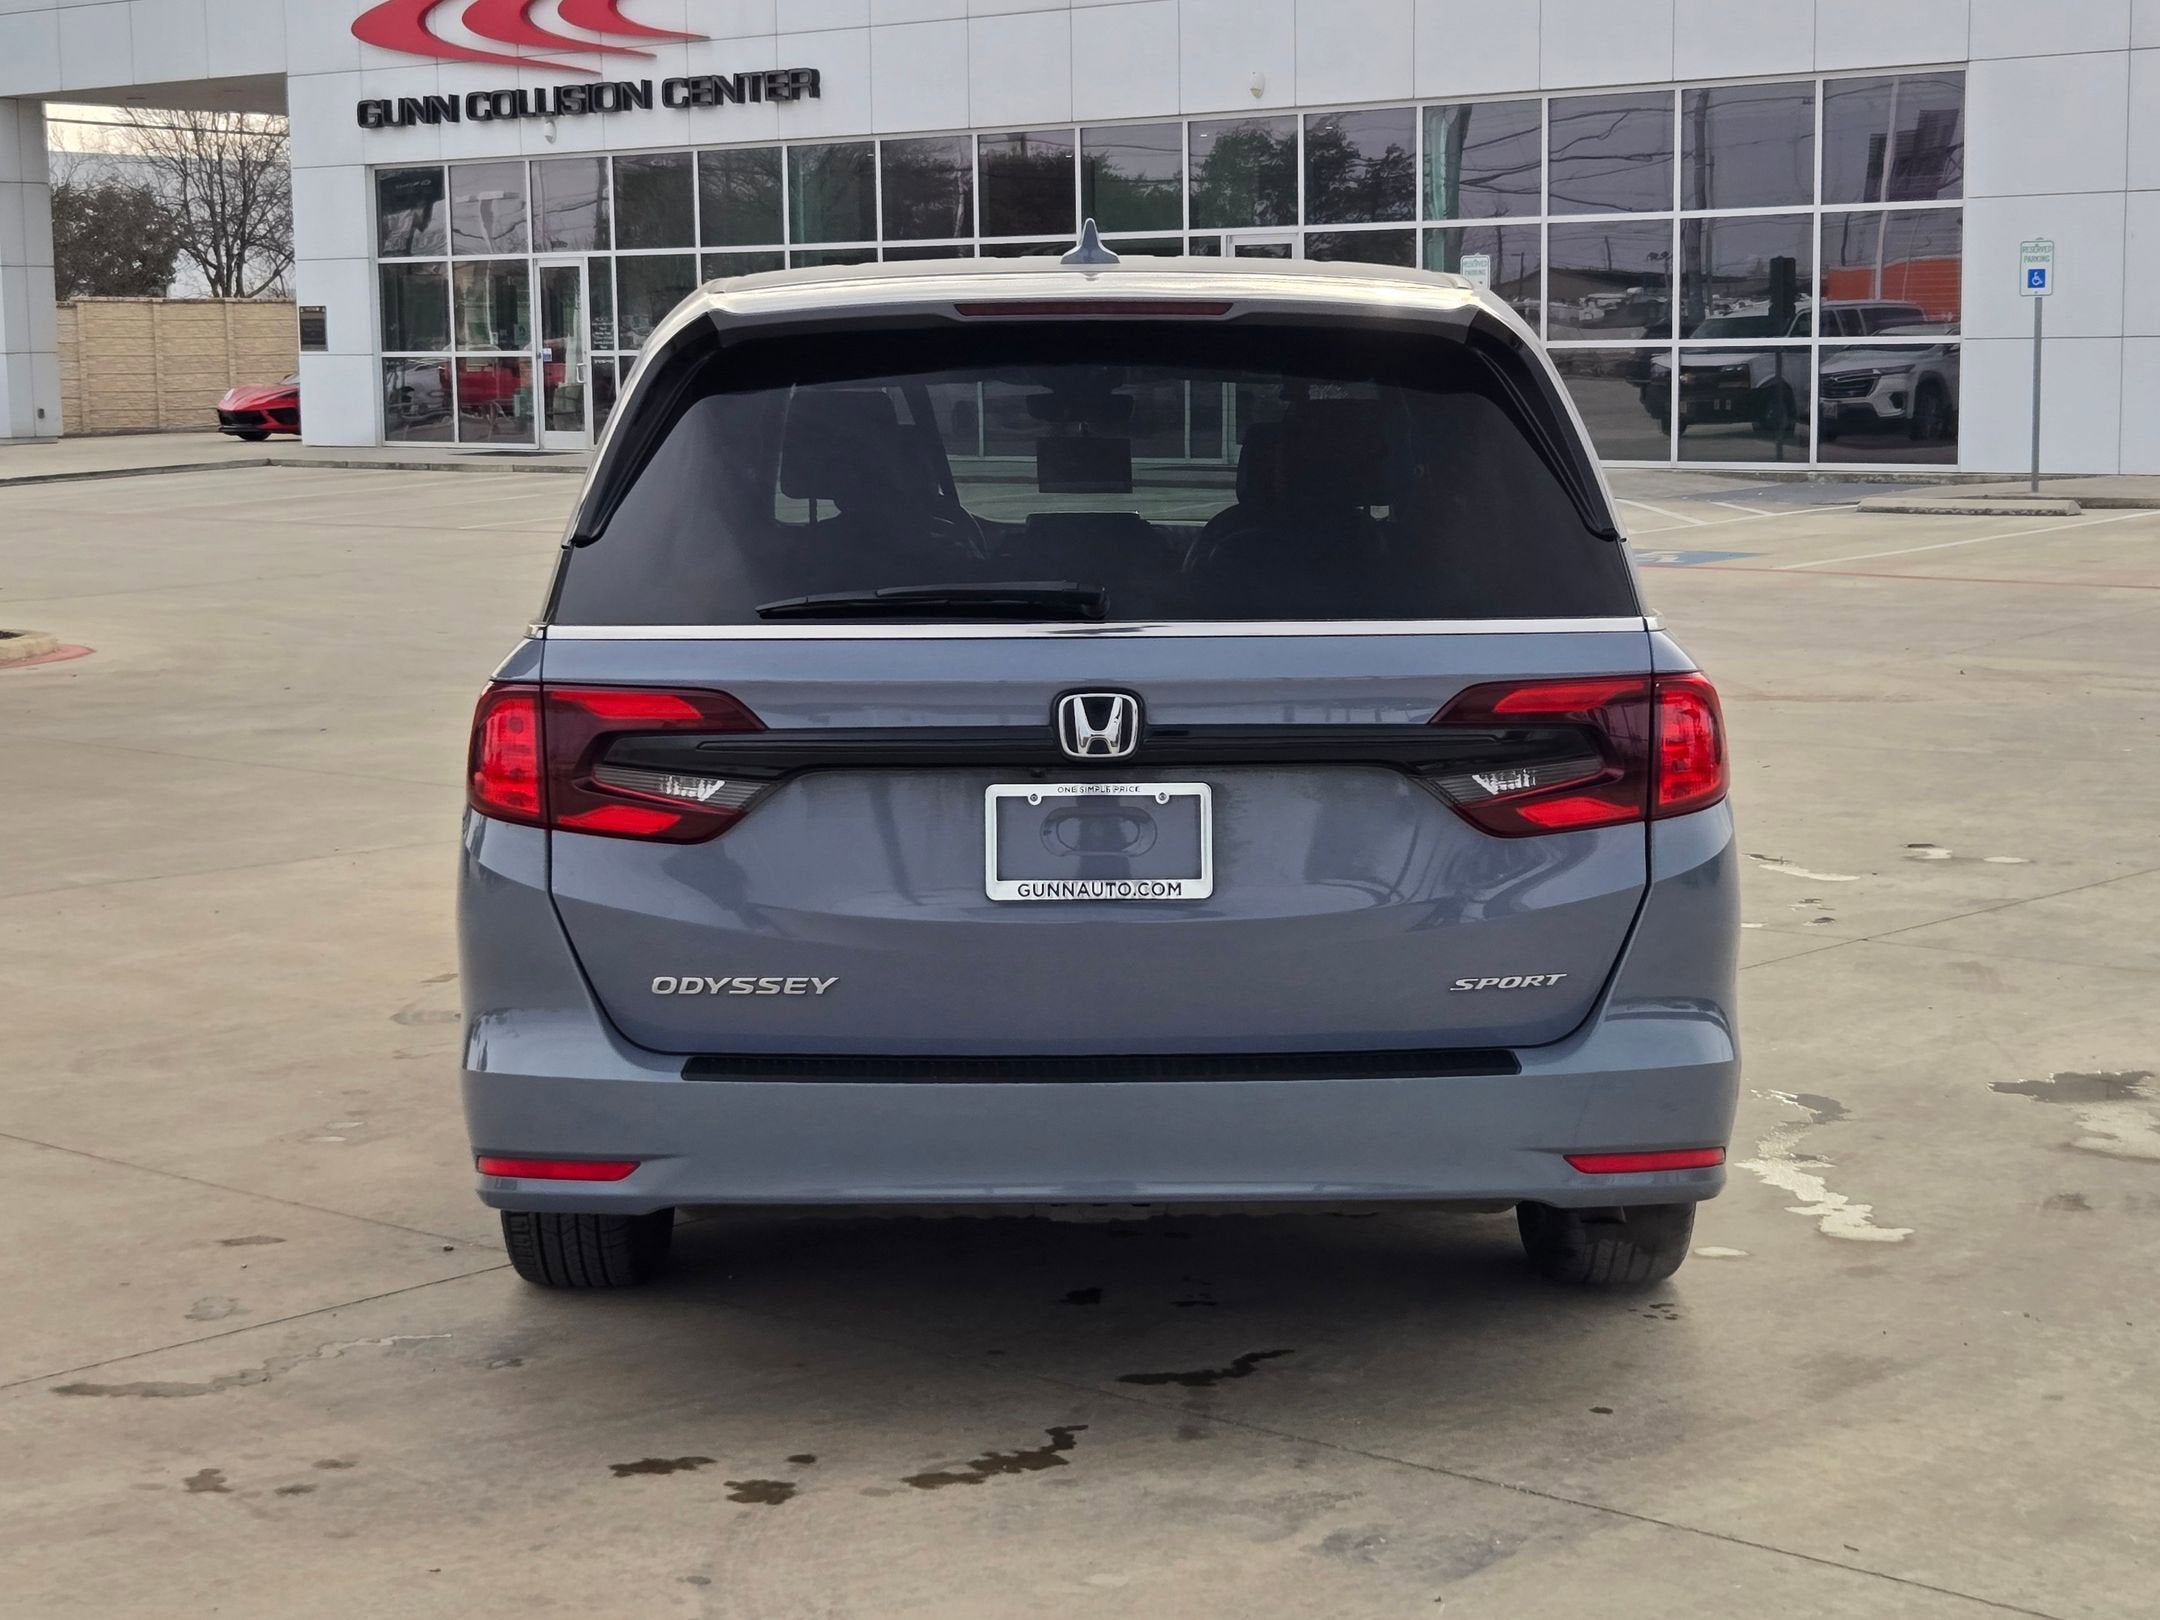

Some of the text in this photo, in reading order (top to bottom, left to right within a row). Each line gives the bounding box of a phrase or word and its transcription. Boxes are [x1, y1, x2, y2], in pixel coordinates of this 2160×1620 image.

[357, 68, 820, 128] GUNN COLLISION CENTER
[1079, 785, 1111, 793] SIMPLE
[1113, 785, 1141, 793] PRICE
[1017, 882, 1182, 897] GUNNAUTO.COM
[651, 976, 839, 995] ODYSSEY
[1450, 973, 1568, 991] SPORT
